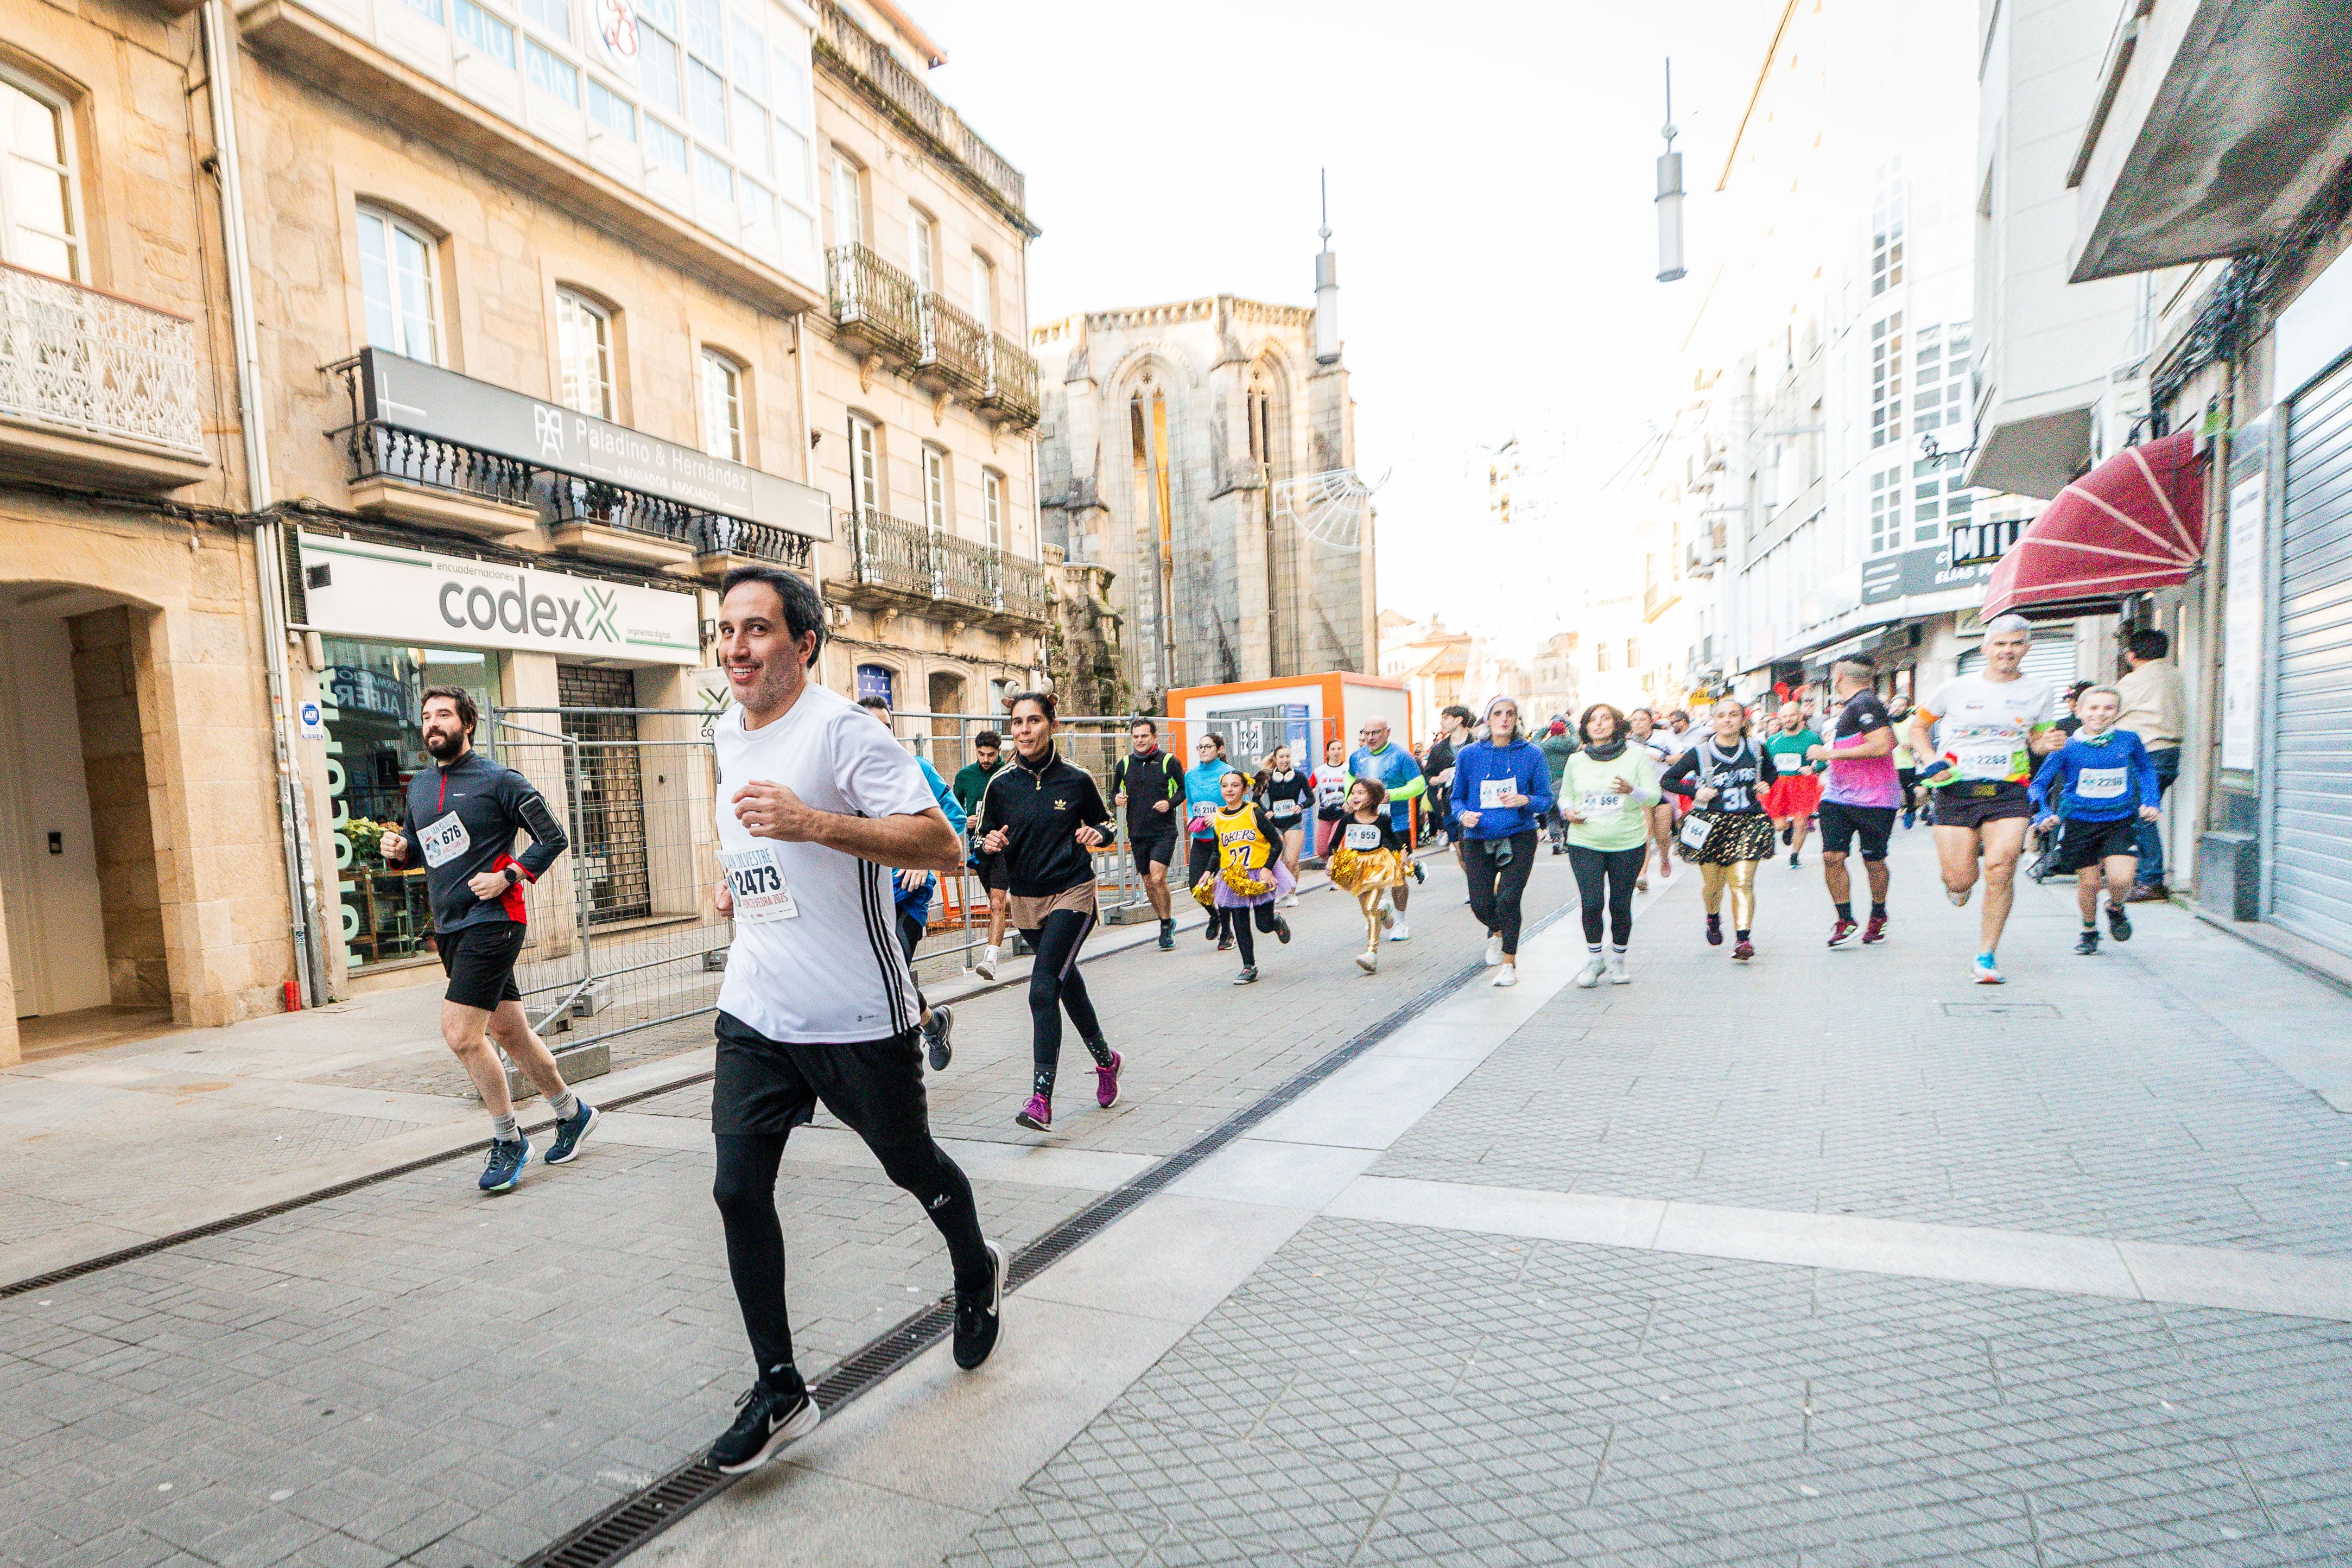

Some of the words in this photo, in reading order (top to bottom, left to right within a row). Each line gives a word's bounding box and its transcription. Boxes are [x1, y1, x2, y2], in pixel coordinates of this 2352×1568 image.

[576, 417, 649, 463] Paladino
[655, 443, 667, 467] &
[671, 448, 749, 491] Hernández
[617, 464, 668, 488] ABOGADOS
[672, 479, 721, 505] ASOCIADOS
[436, 561, 515, 581] encuadernaciones
[439, 575, 584, 639] codex
[627, 626, 654, 639] imprenta
[654, 629, 670, 640] digital
[1722, 786, 1750, 811] 31
[442, 824, 461, 845] 676
[1221, 829, 1257, 847] LAKERS
[735, 848, 773, 868] SILVESTRE
[735, 866, 781, 896] 2473
[773, 892, 788, 904] 2025
